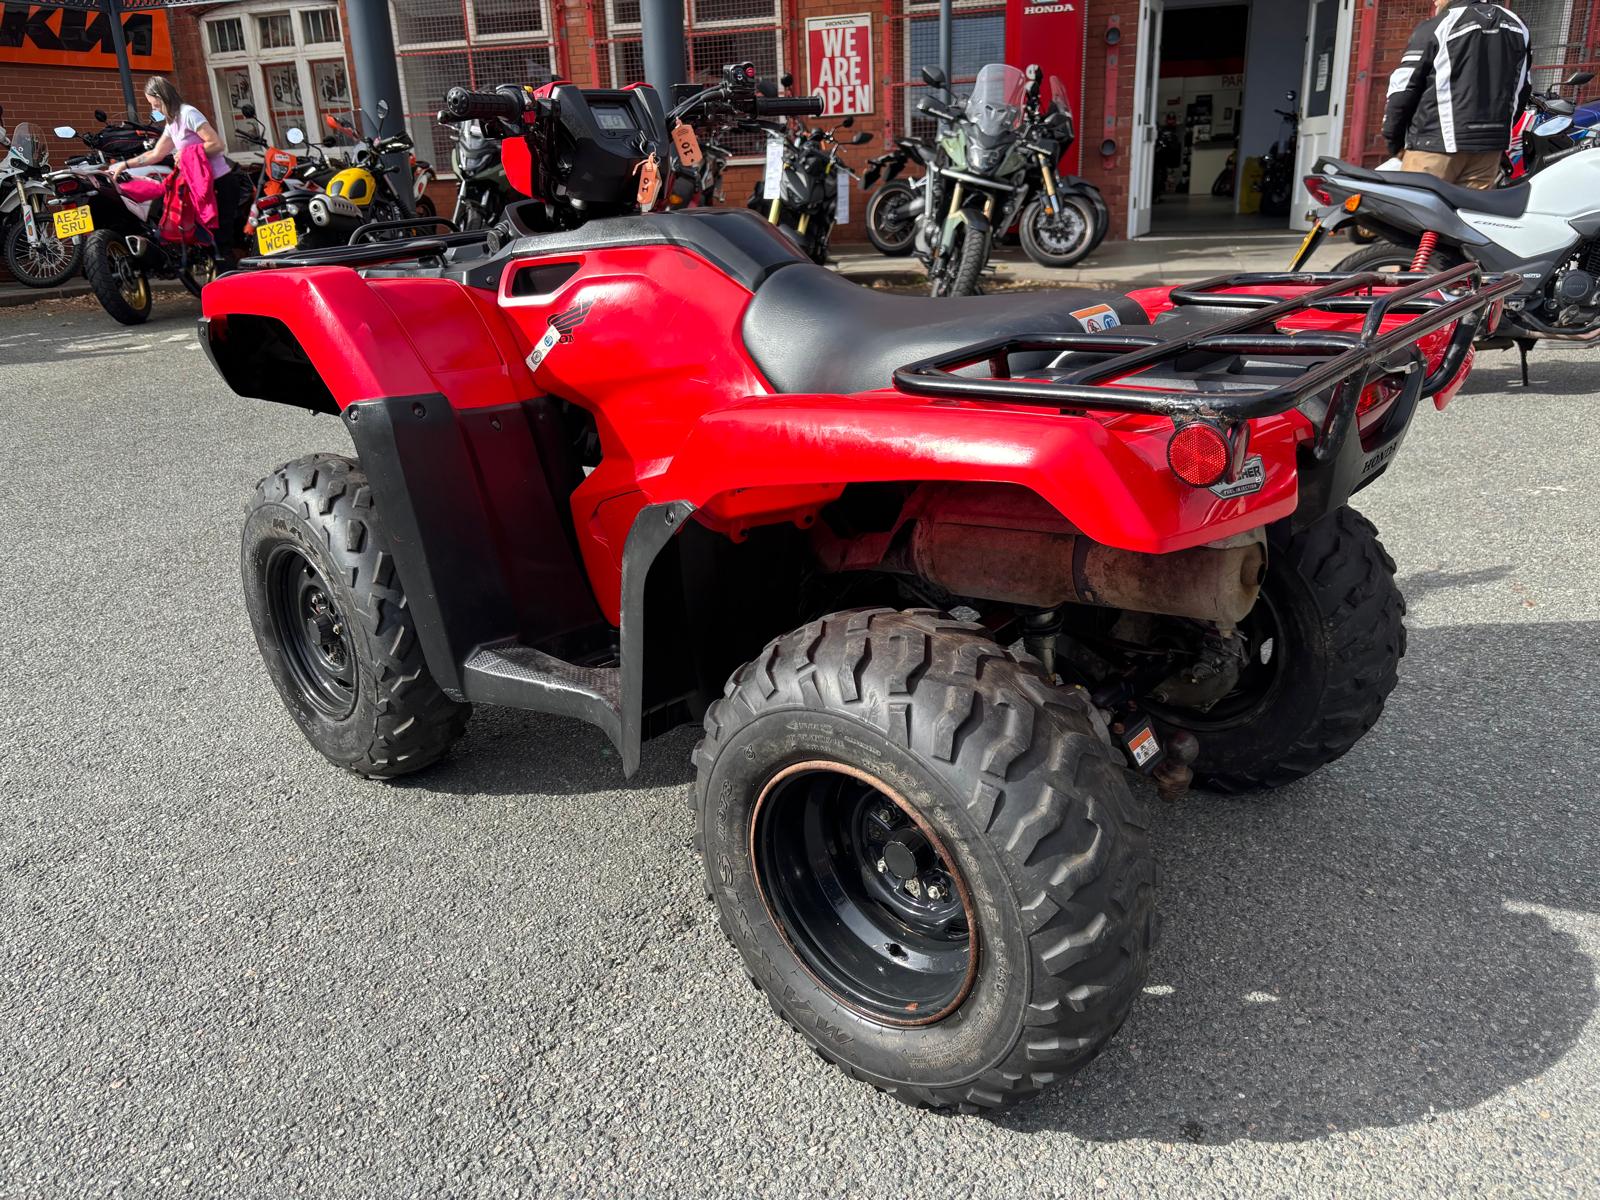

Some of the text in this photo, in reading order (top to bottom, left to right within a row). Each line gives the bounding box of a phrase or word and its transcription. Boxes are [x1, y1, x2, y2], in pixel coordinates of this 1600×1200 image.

[1024, 3, 1075, 15] HONDA
[821, 28, 857, 57] WE
[818, 57, 862, 87] ARE
[57, 208, 88, 224] AE25
[61, 220, 86, 234] SRU
[265, 234, 291, 251] WCG
